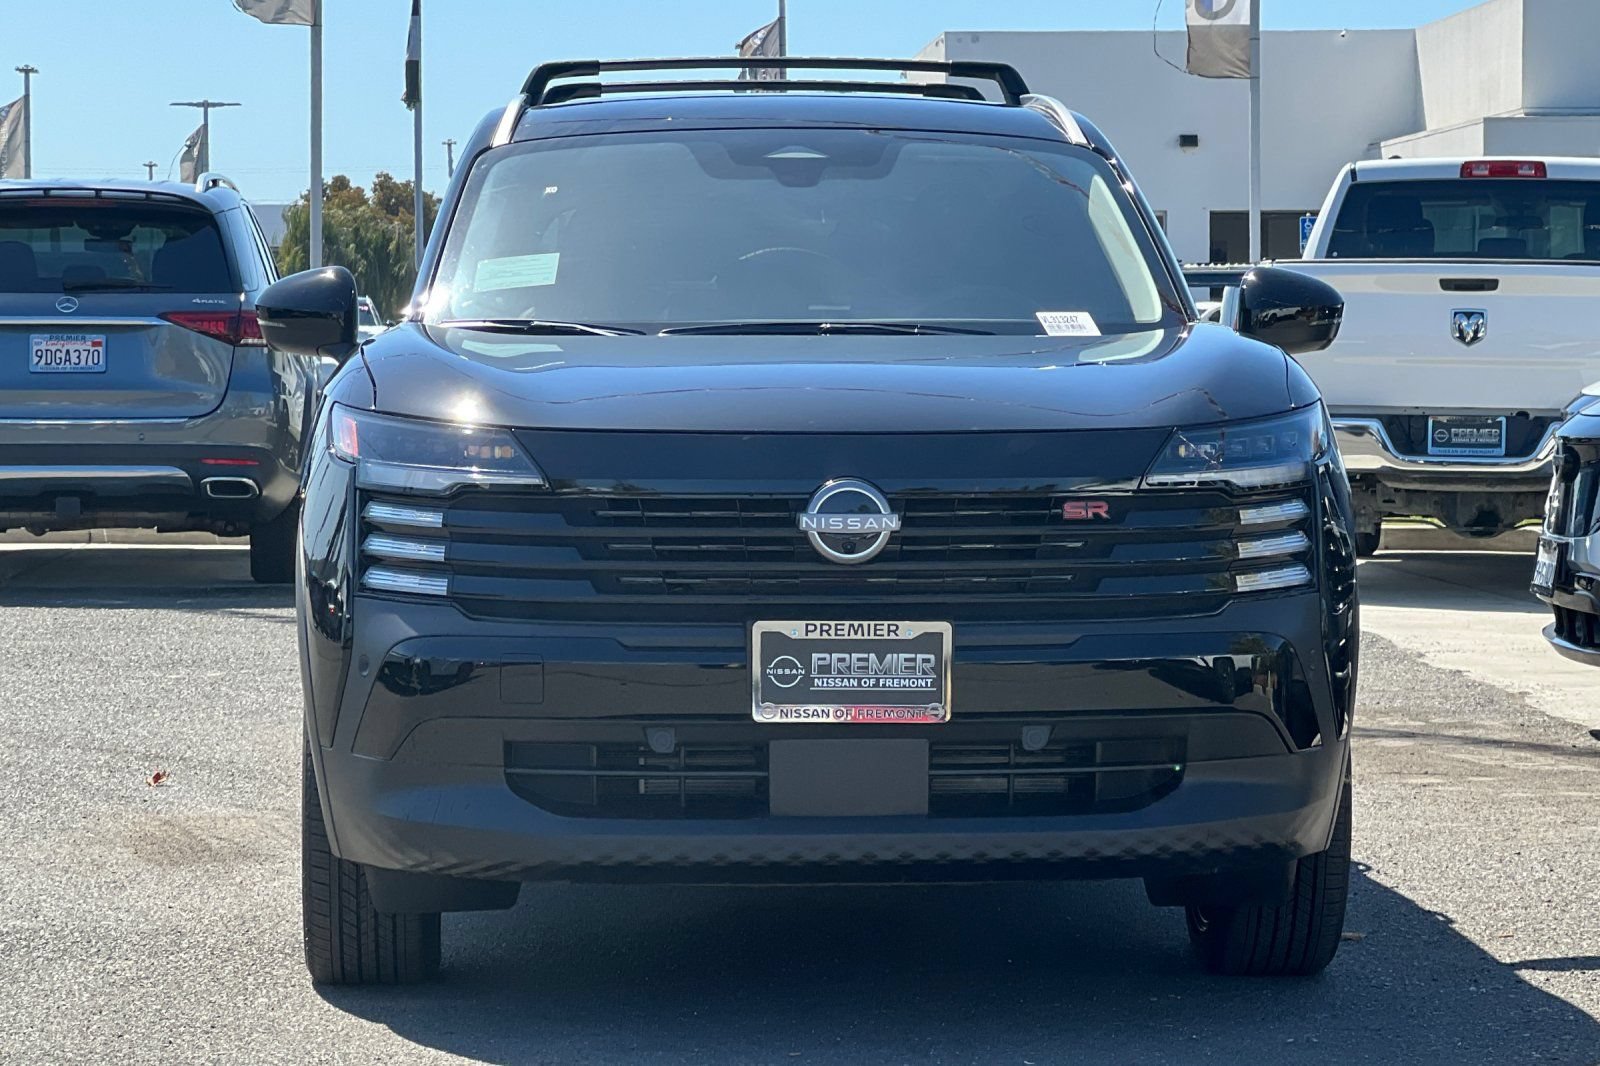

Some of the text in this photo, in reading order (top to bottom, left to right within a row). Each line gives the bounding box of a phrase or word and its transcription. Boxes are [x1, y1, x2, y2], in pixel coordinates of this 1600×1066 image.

[35, 349, 100, 366] 9DGA370
[1451, 428, 1500, 438] PREMIER
[1063, 501, 1111, 520] SR
[802, 516, 896, 530] NISSAN
[805, 623, 900, 637] PREMIER
[811, 653, 936, 676] PREMIER
[814, 678, 933, 687] NISSAN OF FREMONT
[779, 708, 925, 719] NISSAN OF FREMONT
